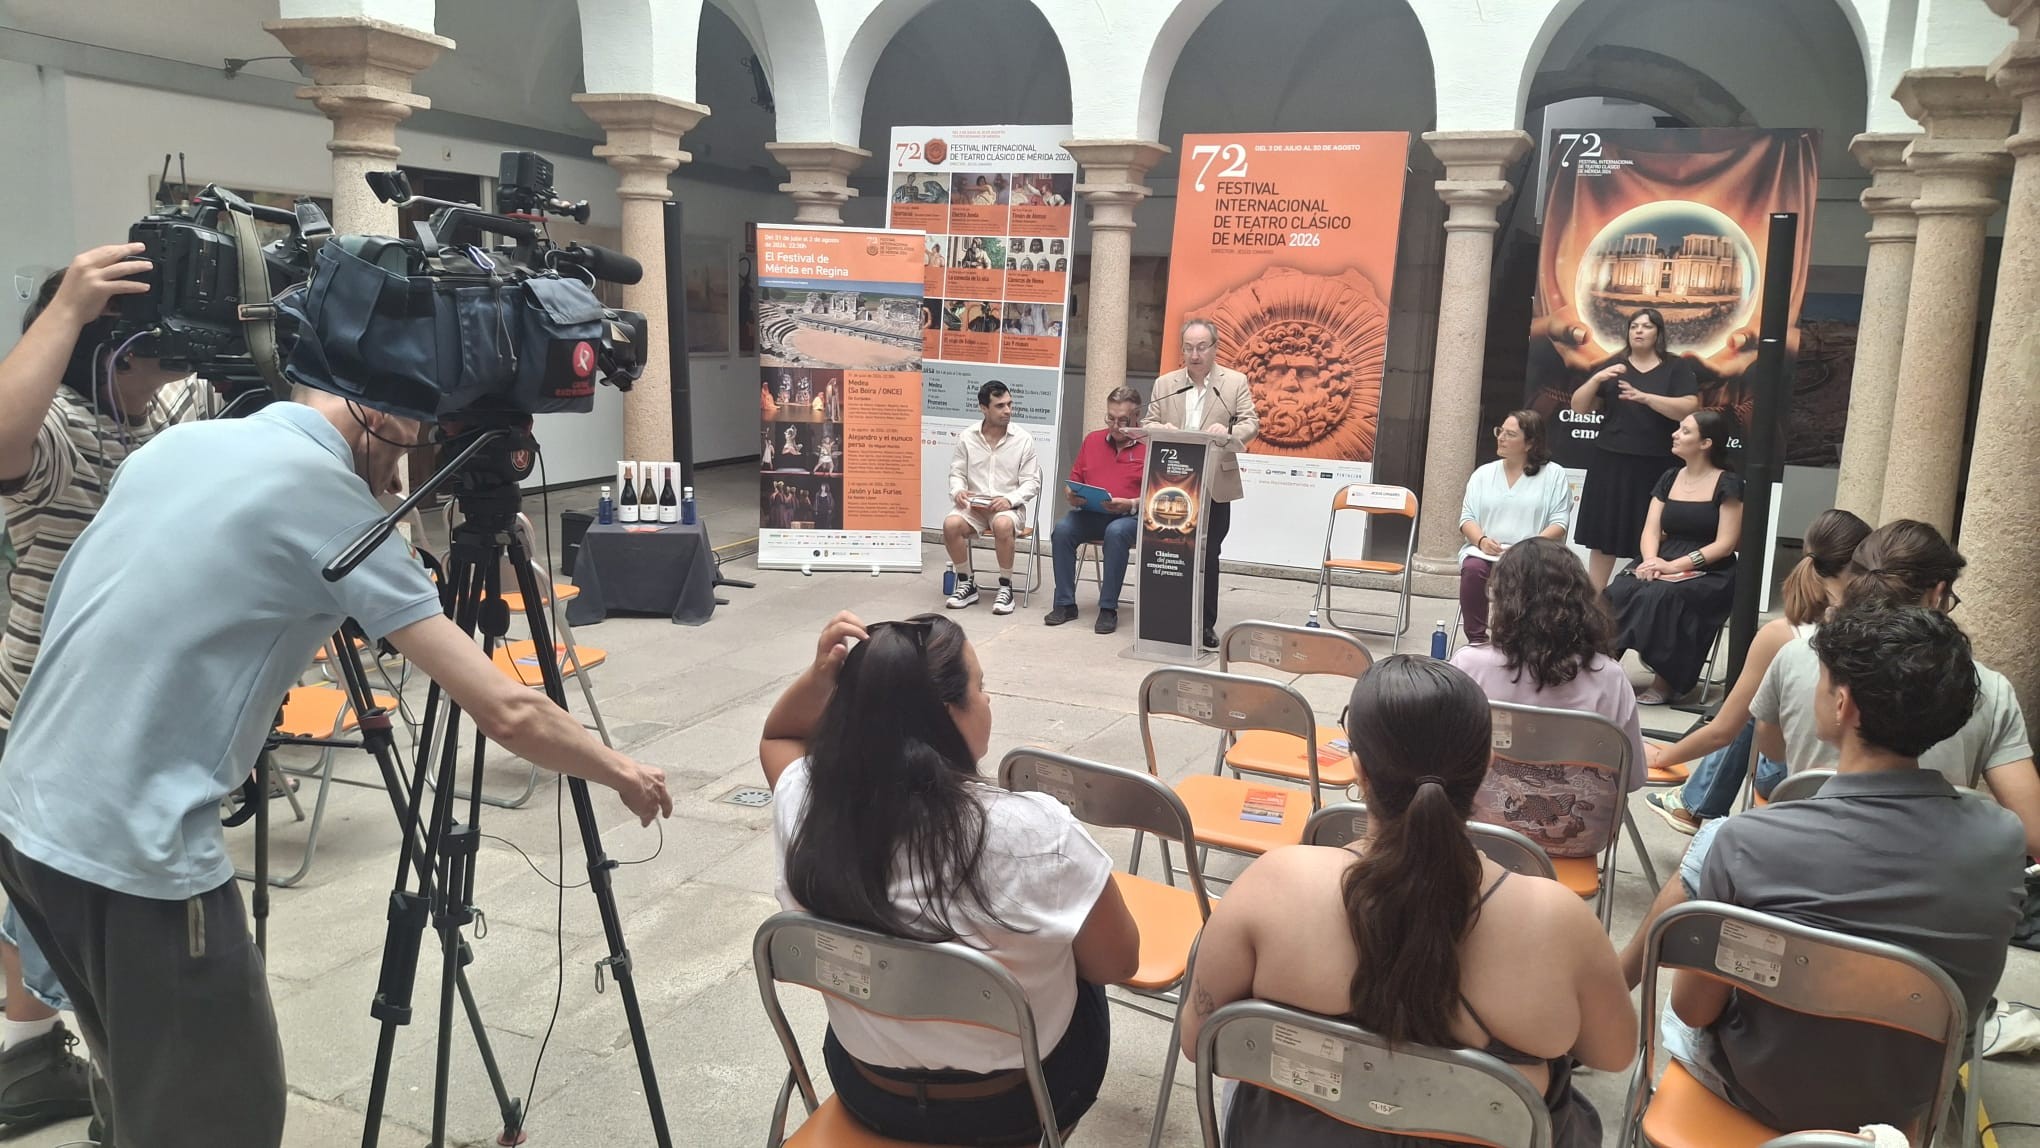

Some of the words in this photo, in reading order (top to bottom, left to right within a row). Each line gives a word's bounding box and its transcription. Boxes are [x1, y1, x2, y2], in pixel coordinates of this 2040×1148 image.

[896, 142, 921, 166] 72
[986, 151, 1015, 160] CLÁSICO
[1027, 151, 1054, 161] MÉRIDA
[1559, 133, 1602, 167] 72
[1192, 144, 1248, 192] 72
[1217, 182, 1279, 195] FESTIVAL
[1215, 199, 1328, 212] INTERNACIONAL
[1214, 215, 1232, 228] DE
[1235, 216, 1287, 229] TEATRO
[1291, 213, 1351, 230] CLÁSICO
[1212, 232, 1230, 245] DE
[1233, 229, 1286, 246] MÉRIDA
[1289, 233, 1320, 247] 2026
[765, 251, 774, 261] El
[777, 252, 814, 263] Festival
[817, 254, 829, 264] de
[765, 263, 799, 274] Mérida
[802, 267, 813, 275] en
[816, 266, 848, 278] Regina
[1160, 449, 1178, 463] 72
